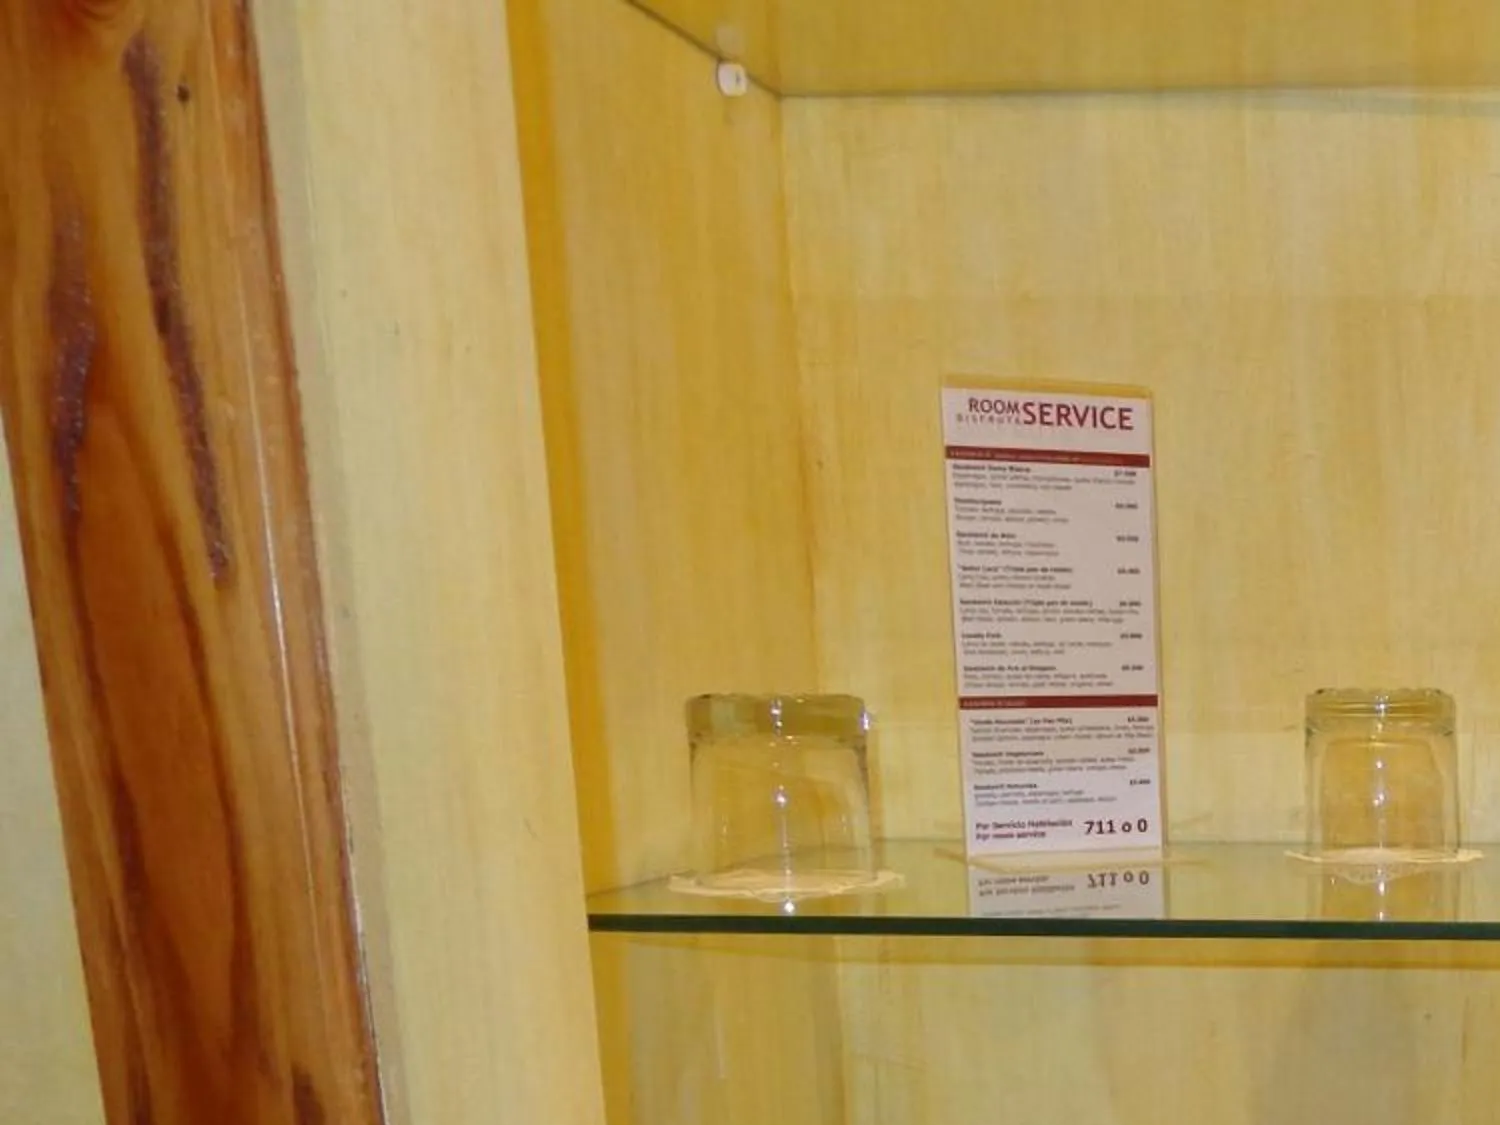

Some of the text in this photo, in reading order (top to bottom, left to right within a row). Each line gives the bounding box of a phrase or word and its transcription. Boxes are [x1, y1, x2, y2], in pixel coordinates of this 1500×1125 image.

[968, 398, 1134, 430] ROOM SERVICE
[1084, 820, 1116, 835] 711
[1137, 818, 1148, 832] 0
